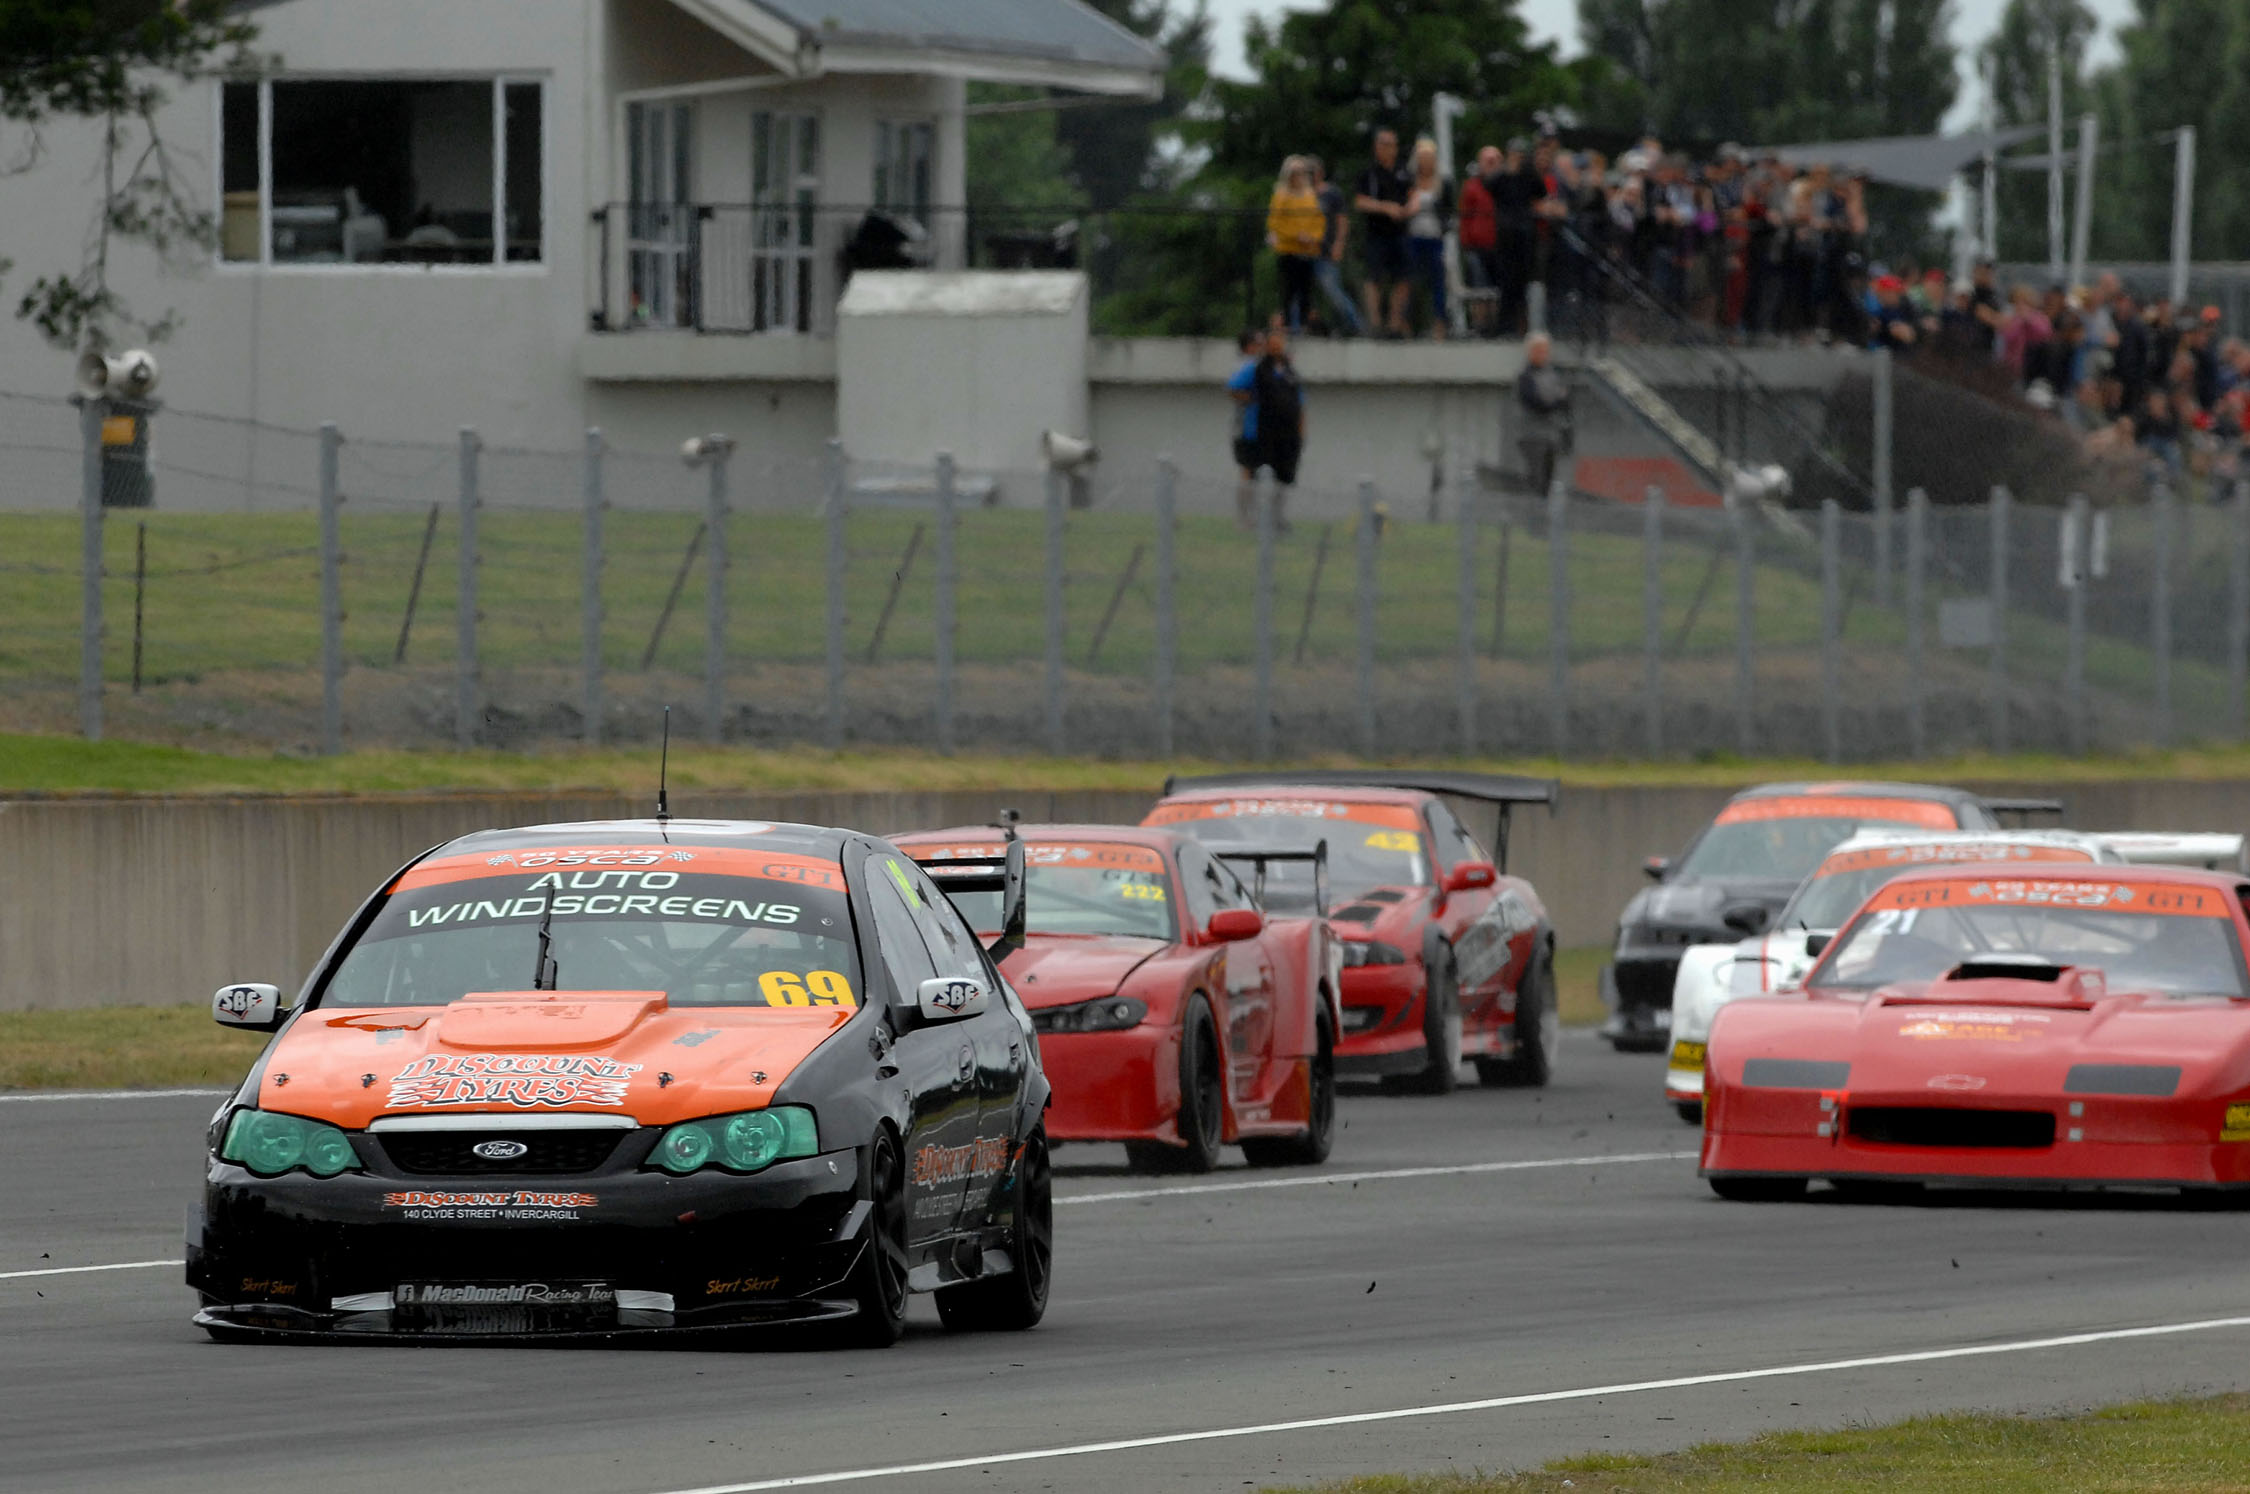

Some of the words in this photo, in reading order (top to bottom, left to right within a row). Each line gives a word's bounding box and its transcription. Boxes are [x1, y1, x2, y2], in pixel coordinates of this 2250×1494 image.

[526, 871, 680, 892] AUTO
[1120, 883, 1167, 901] 222
[408, 895, 802, 928] WINDSCREENS
[758, 970, 857, 1008] 69
[392, 1054, 644, 1080] DISCOUNT
[422, 1075, 589, 1107] TYRES
[484, 1142, 516, 1157] Ford
[401, 1190, 508, 1207] DISCOUNT
[513, 1190, 581, 1207] TYRES
[403, 1209, 420, 1219] 140
[421, 1209, 455, 1219] CLYDE
[457, 1209, 497, 1219] STREET
[504, 1209, 580, 1220] INVERCARGILL
[422, 1284, 526, 1302] MacDonald
[523, 1283, 582, 1303] Racing
